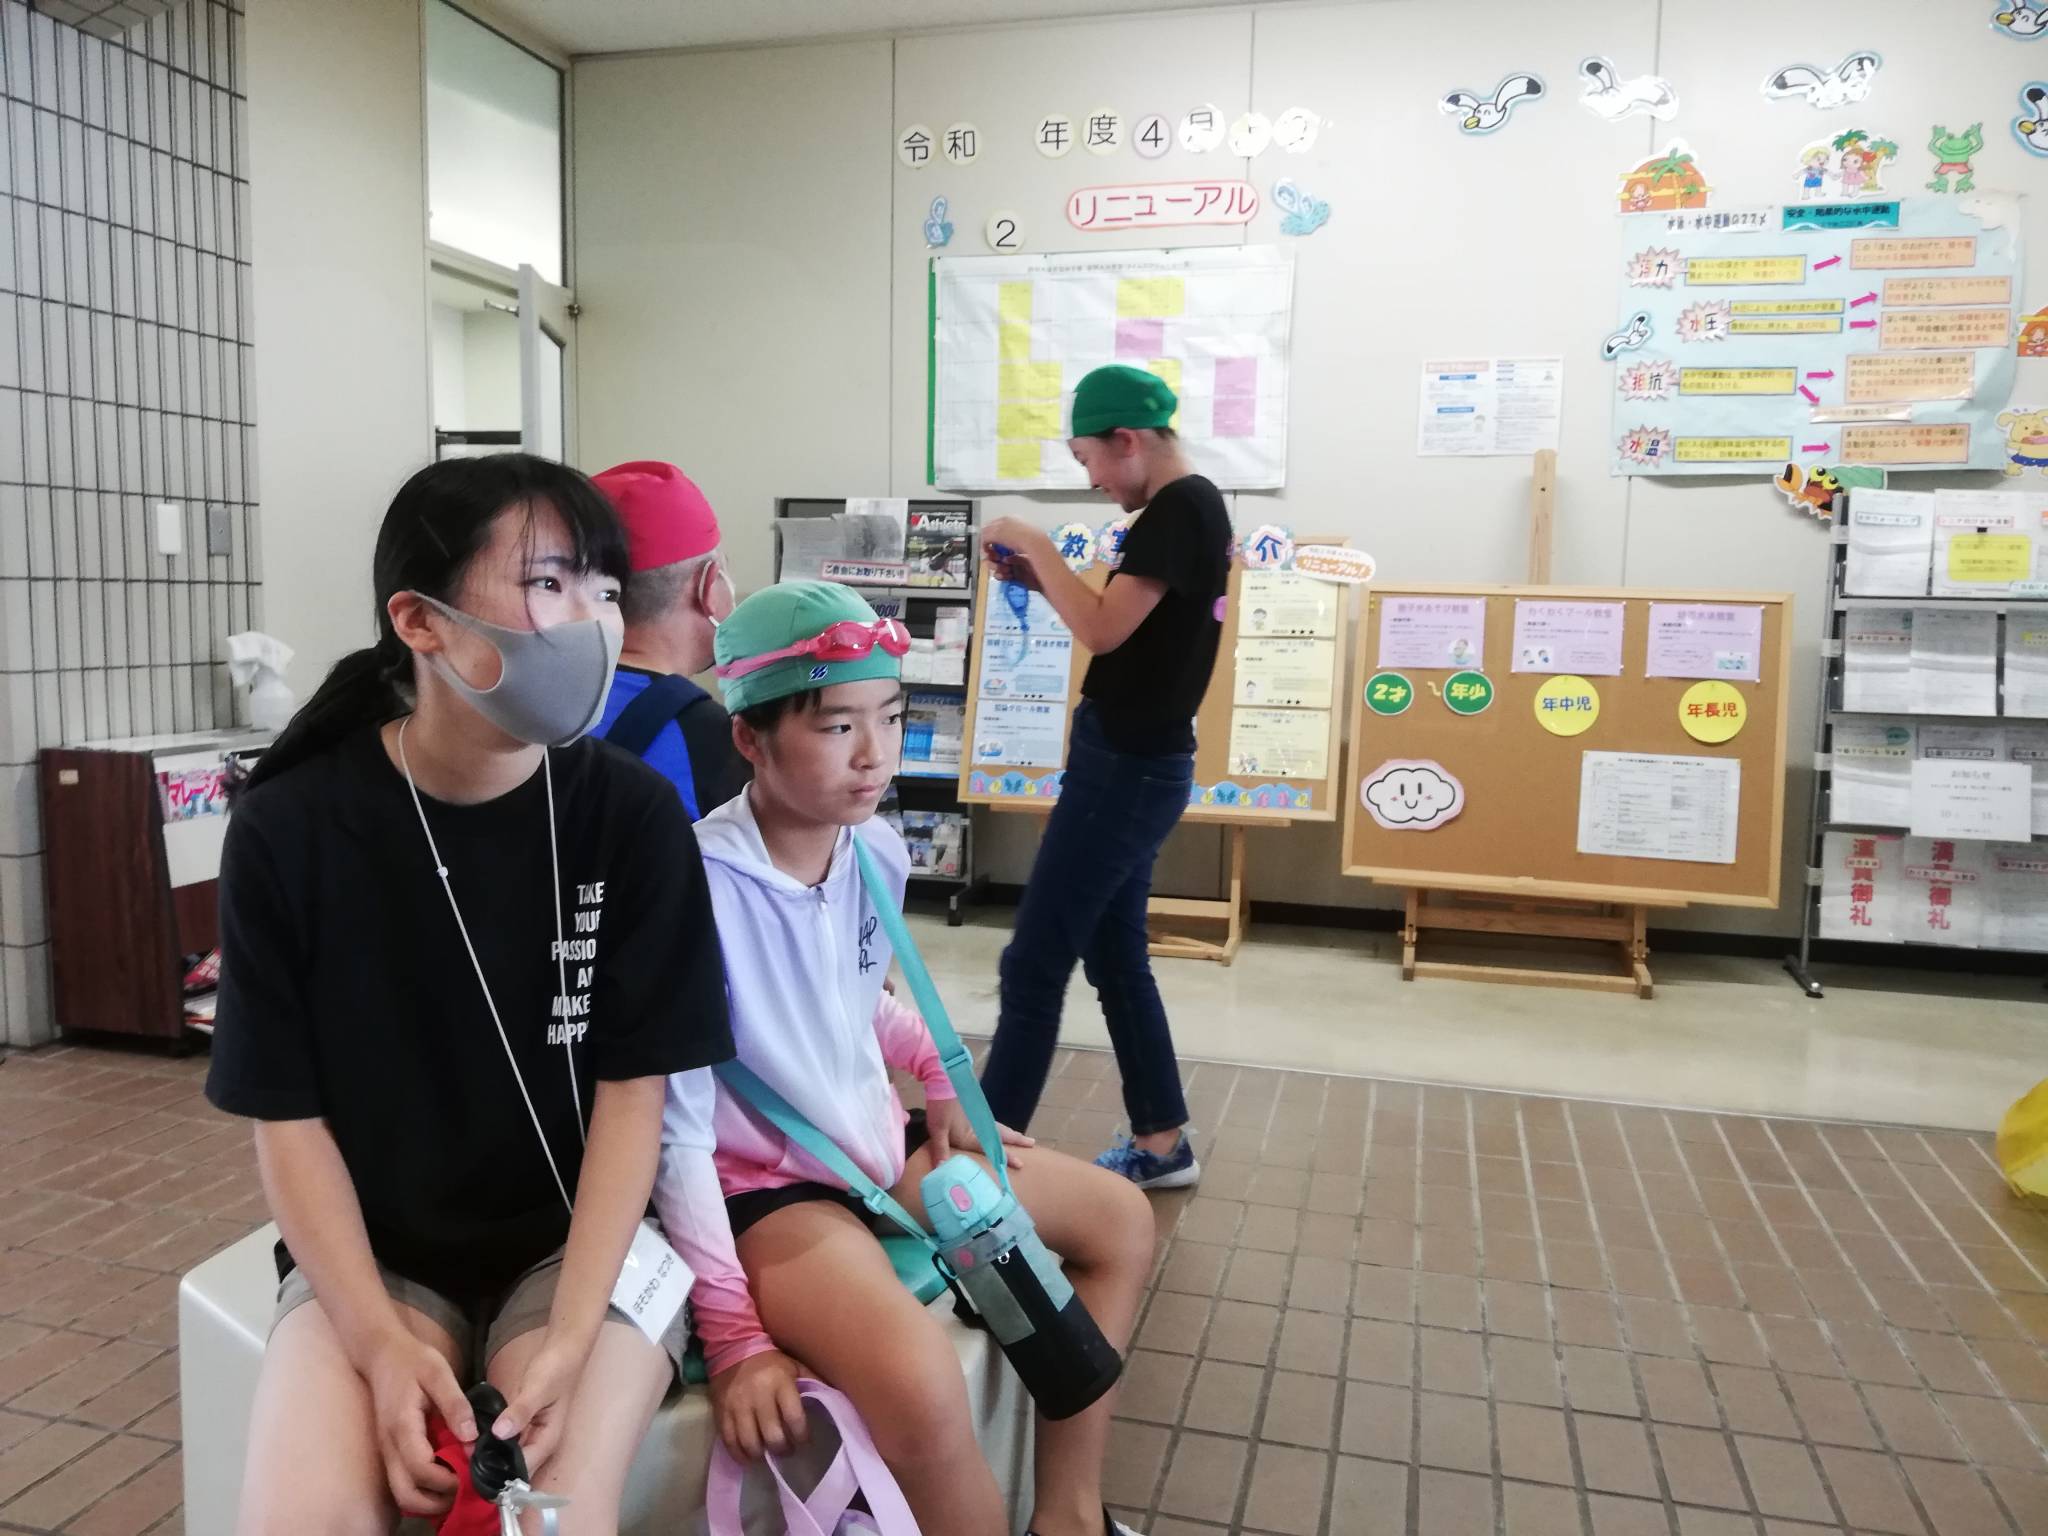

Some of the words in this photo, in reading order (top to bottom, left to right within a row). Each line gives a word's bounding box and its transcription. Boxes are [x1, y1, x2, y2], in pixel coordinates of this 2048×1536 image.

[903, 130, 976, 162] 令和
[1075, 186, 1256, 226] リニューアル
[995, 220, 1016, 248] 2
[1256, 535, 1283, 562] 介
[1374, 683, 1408, 703] 2才
[1450, 683, 1487, 701] 年少
[1542, 696, 1593, 712] 年中児
[1687, 703, 1738, 718] 年長児
[576, 881, 605, 905] TAKE
[552, 993, 591, 1017] MAKE
